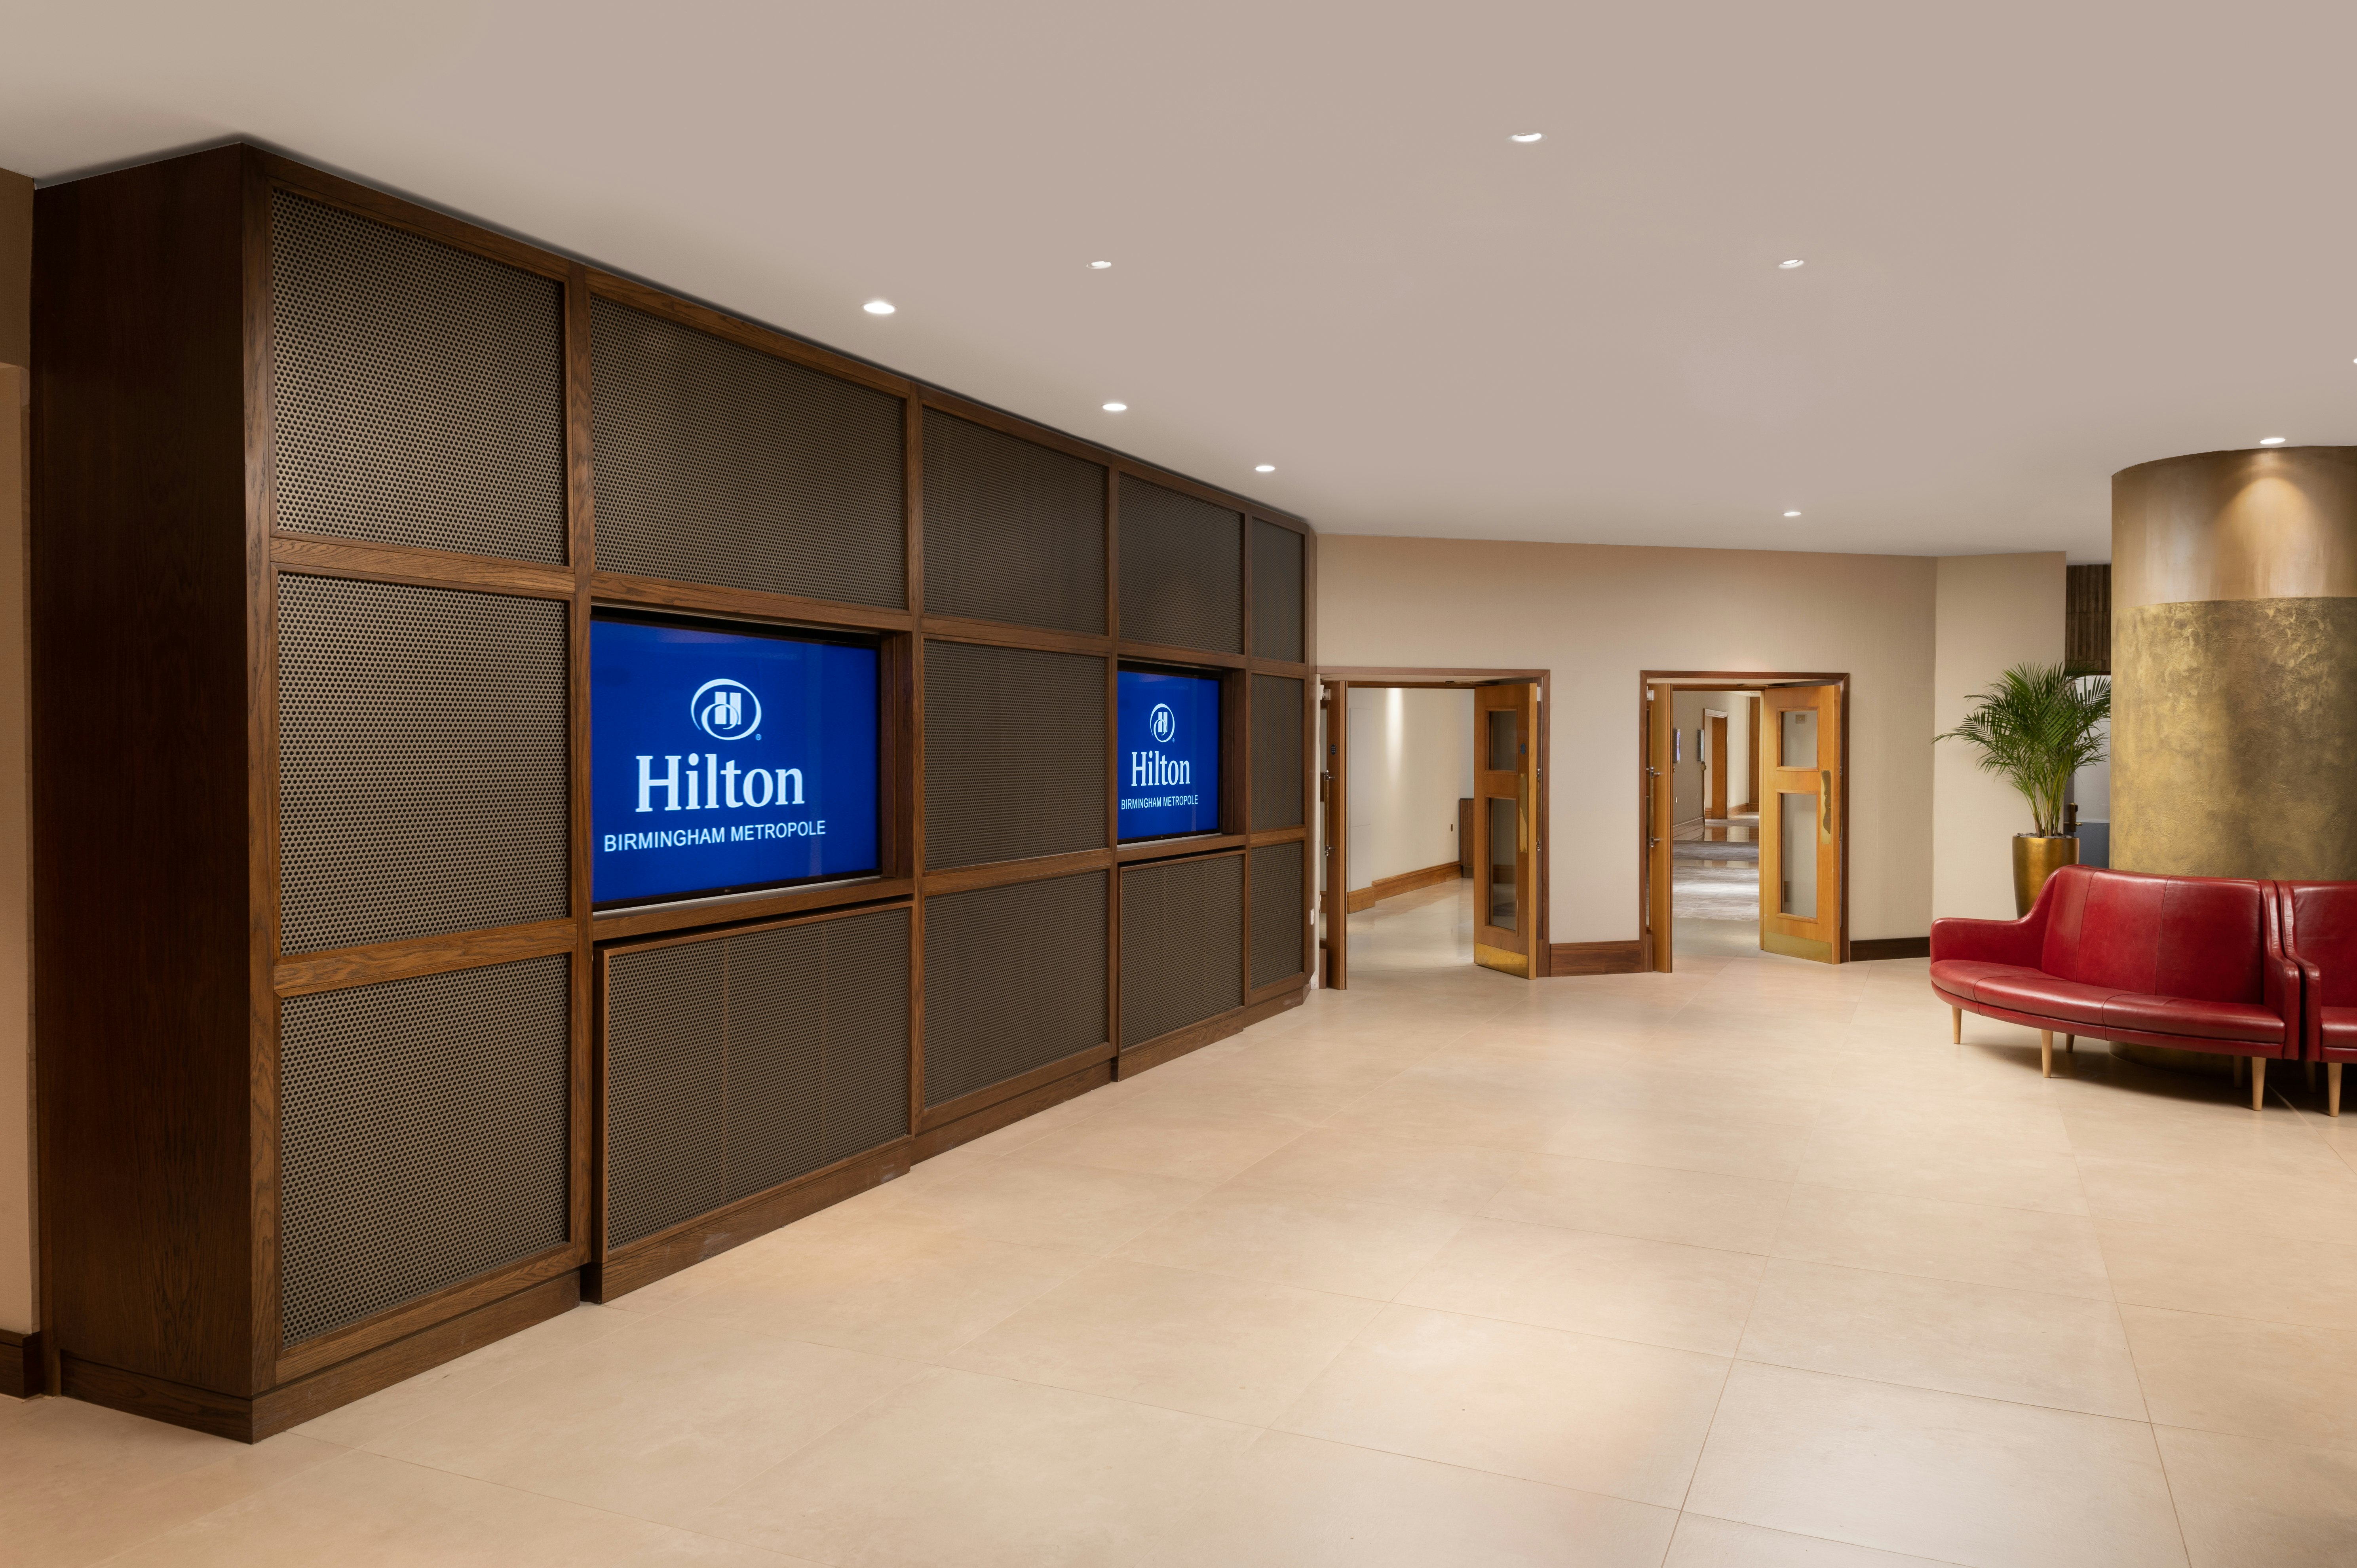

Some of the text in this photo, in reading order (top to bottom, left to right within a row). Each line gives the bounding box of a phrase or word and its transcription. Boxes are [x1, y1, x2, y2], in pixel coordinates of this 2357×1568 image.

[635, 753, 805, 812] Hilton
[1131, 750, 1190, 787] Hilton
[1121, 794, 1198, 810] BIRMINGHAM METROPOLE
[604, 820, 826, 852] BIRMINGHAM METROPOLE
